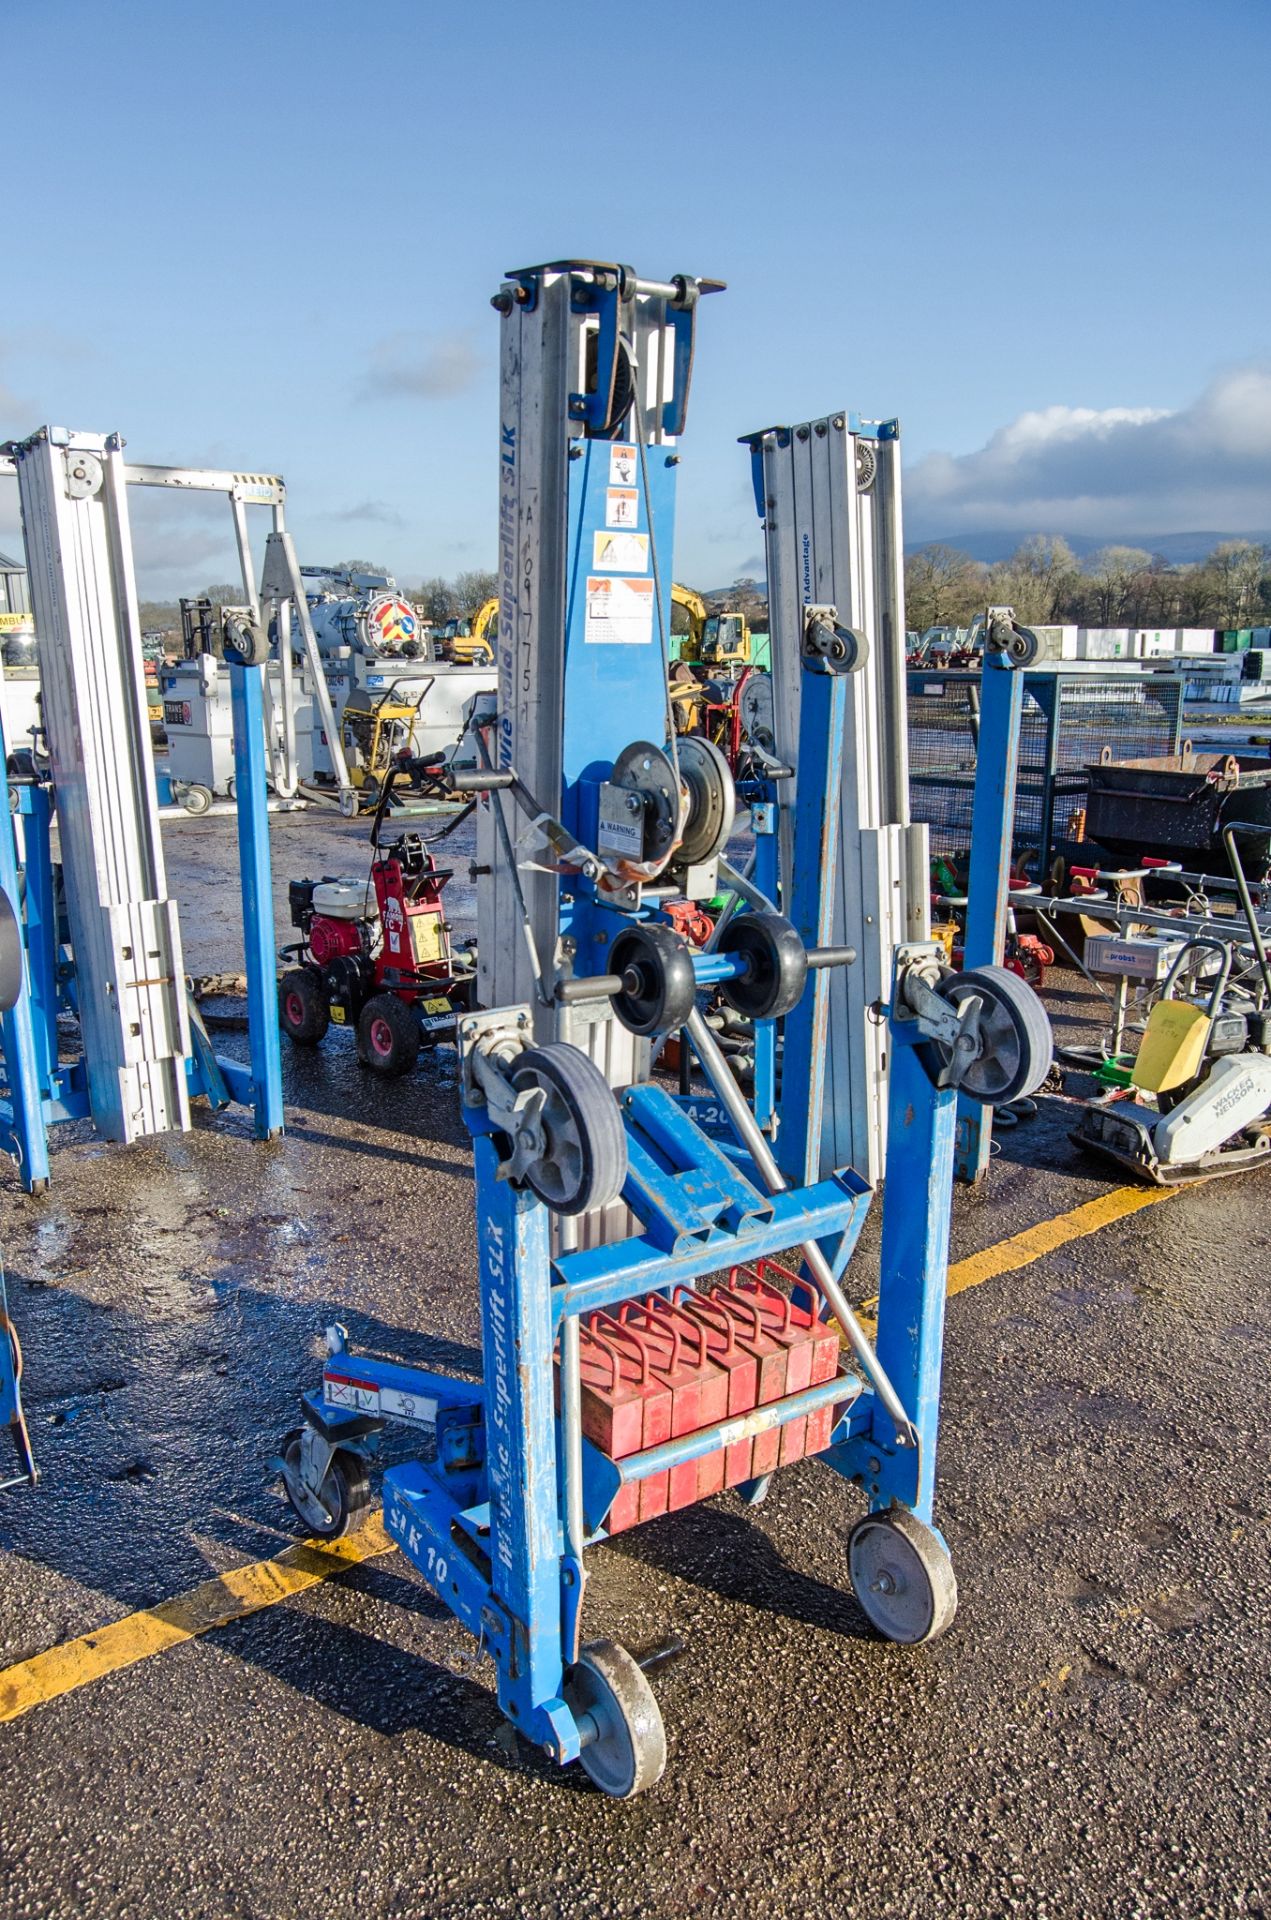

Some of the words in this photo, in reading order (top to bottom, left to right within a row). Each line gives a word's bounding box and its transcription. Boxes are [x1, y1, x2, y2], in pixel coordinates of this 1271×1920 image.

[502, 423, 516, 487] SLK
[500, 494, 517, 641] Superlift
[802, 533, 812, 592] Advantage
[500, 644, 514, 769] Wieold
[607, 822, 636, 837] WARNING
[1110, 953, 1137, 963] probst
[1212, 1077, 1253, 1110] WACKER
[1215, 1083, 1255, 1118] NEUSON
[487, 1216, 504, 1286] SLK
[489, 1288, 512, 1435] Superlift
[390, 1508, 423, 1556] SLK
[427, 1547, 448, 1583] 10
